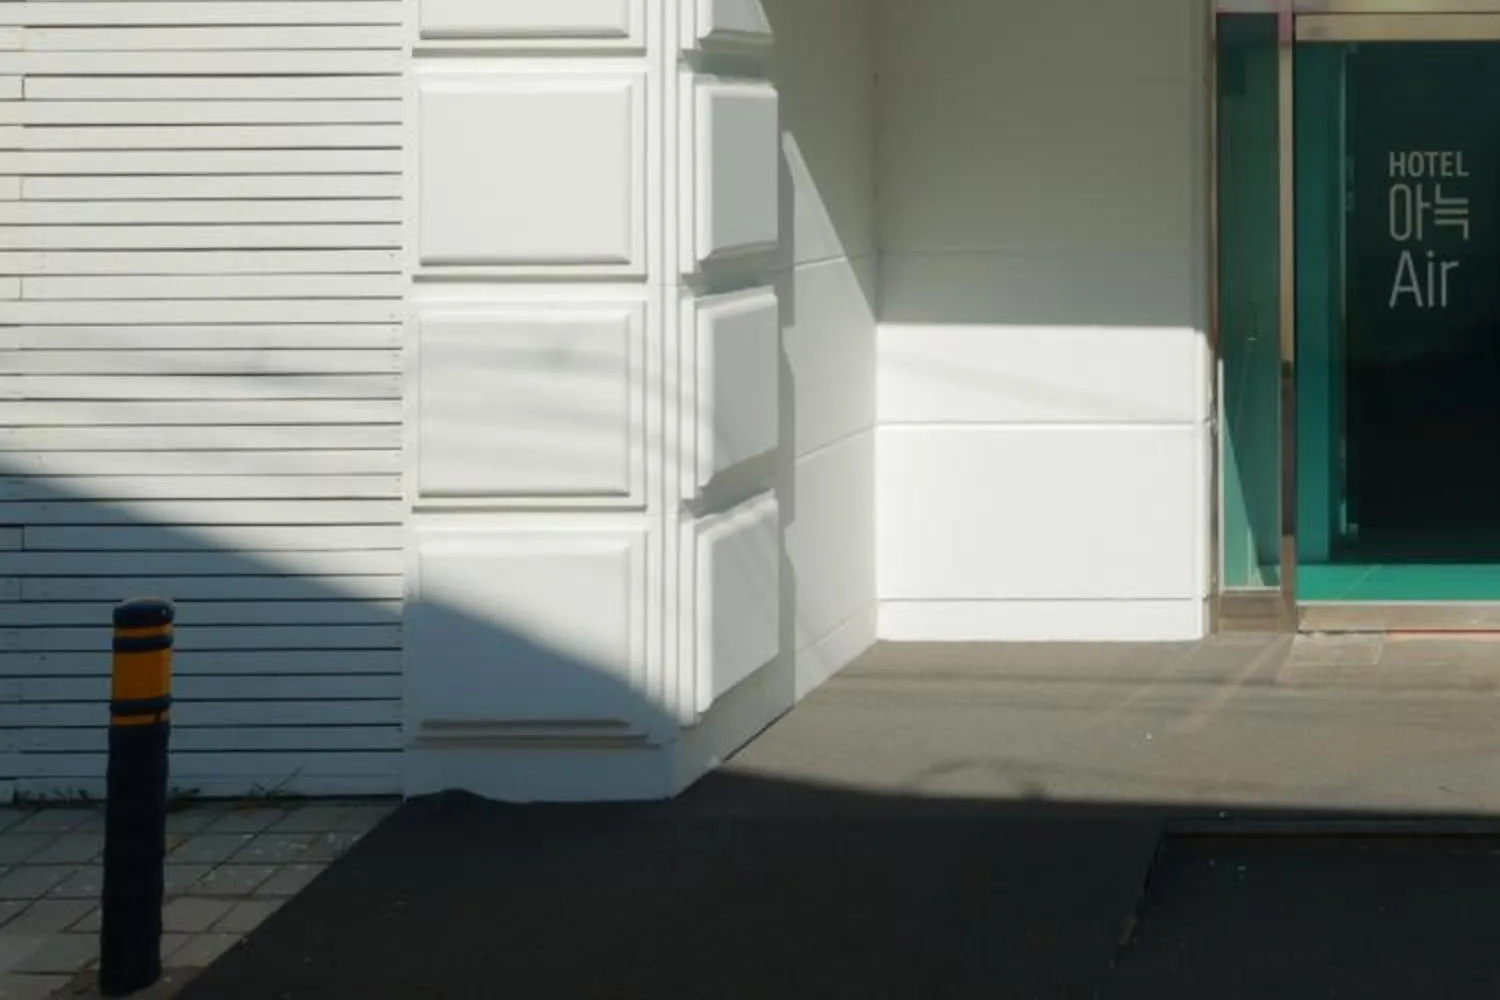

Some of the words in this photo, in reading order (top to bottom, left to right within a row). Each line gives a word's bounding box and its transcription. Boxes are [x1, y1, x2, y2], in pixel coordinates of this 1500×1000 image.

[1389, 151, 1470, 178] HOTEL
[1389, 183, 1470, 241] 아늑
[1389, 250, 1460, 309] Air
